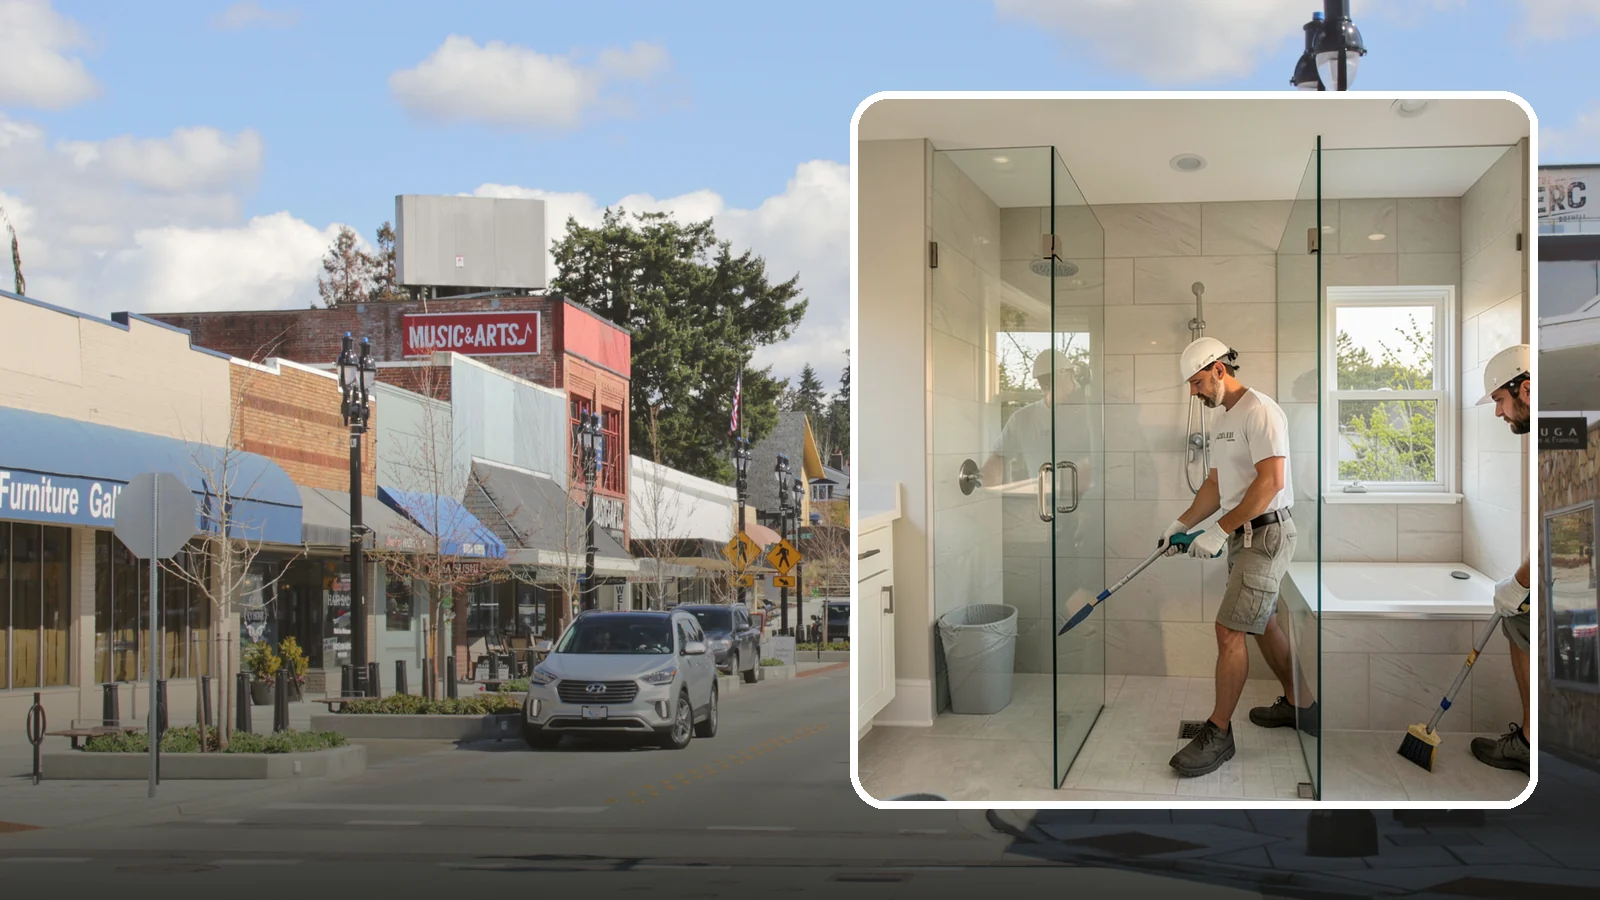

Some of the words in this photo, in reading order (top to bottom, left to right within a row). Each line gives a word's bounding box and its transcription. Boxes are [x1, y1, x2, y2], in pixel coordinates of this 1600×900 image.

[1540, 427, 1577, 436] UGA
[0, 472, 79, 515] Furniture
[89, 482, 122, 519] Gal
[453, 563, 480, 574] SUSHI
